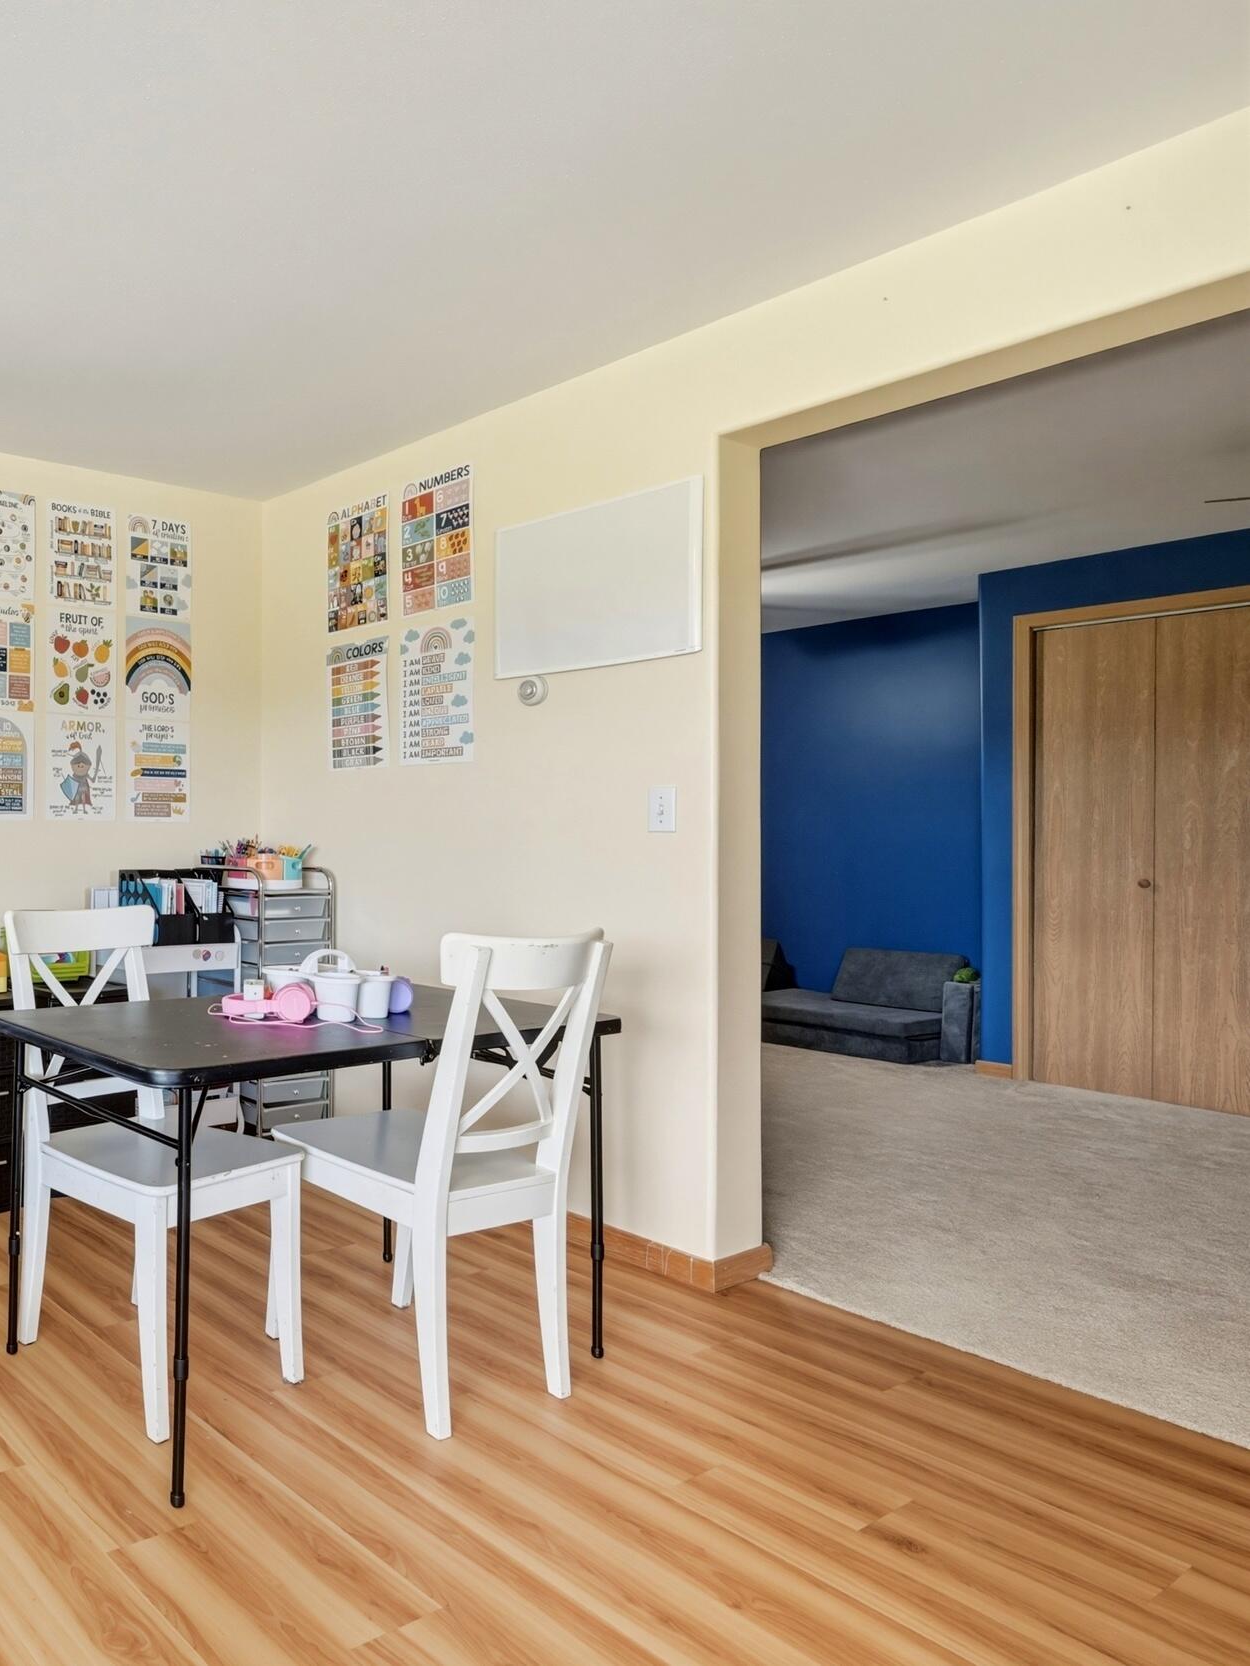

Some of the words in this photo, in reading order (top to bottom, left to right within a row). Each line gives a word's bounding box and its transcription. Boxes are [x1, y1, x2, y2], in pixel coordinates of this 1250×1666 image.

[418, 464, 470, 493] NUMBERS
[51, 502, 78, 514] BOOKS
[90, 508, 111, 519] BIBLE
[341, 494, 387, 520] ALPHABET
[440, 514, 447, 527] 7
[151, 520, 158, 530] 7
[161, 521, 187, 535] DAYS
[403, 526, 411, 539] 2
[406, 549, 413, 562] 3
[59, 612, 88, 625] FRUIT
[90, 616, 104, 627] OF
[78, 627, 98, 636] spirit
[346, 641, 384, 660] COLORS
[409, 658, 420, 666] AM
[141, 691, 175, 705] GOD'S
[139, 704, 175, 714] promises
[2, 721, 12, 730] 10
[60, 720, 102, 733] ARMOR
[141, 724, 153, 732] THE
